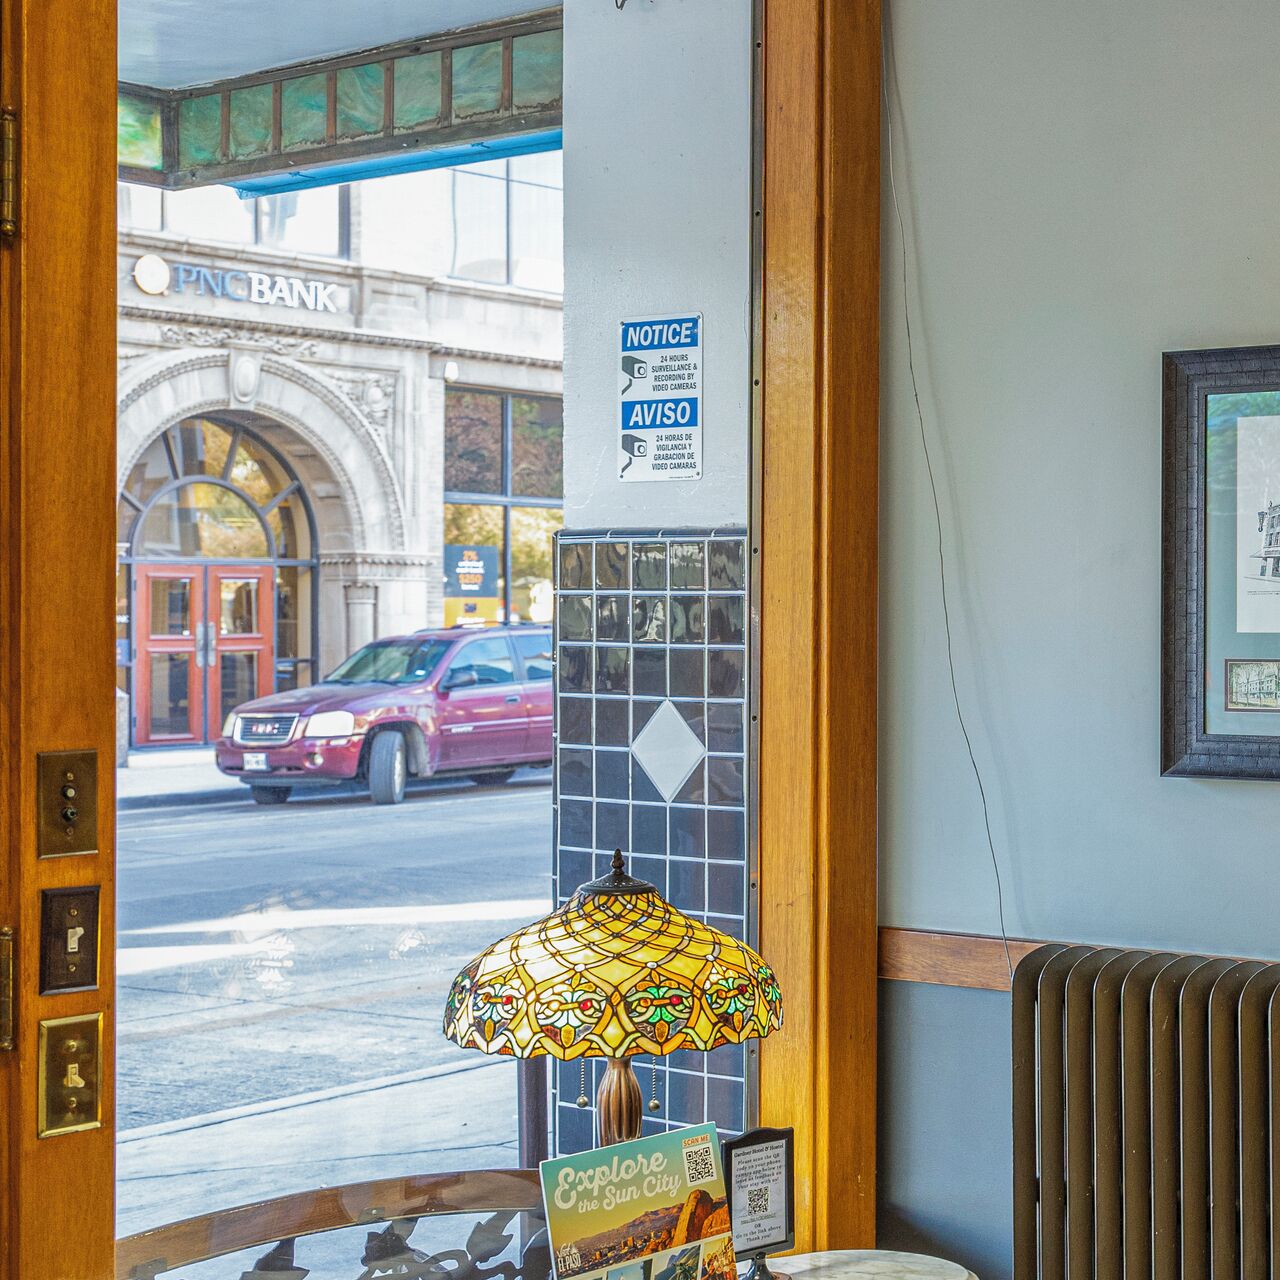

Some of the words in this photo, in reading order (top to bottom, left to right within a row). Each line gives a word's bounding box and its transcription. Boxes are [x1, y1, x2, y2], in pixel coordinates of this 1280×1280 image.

[173, 264, 248, 301] PNC
[247, 272, 338, 313] BANK
[626, 322, 692, 347] NOTICE
[669, 354, 688, 362] HOURS
[652, 364, 691, 373] SURVEILLANCE
[654, 374, 685, 382] RECORDING
[652, 384, 668, 392] VIDEO
[670, 382, 696, 391] CAMERAS
[629, 401, 690, 426] AVISO
[654, 453, 686, 461] GRABACION
[687, 452, 694, 460] DE
[670, 462, 696, 470] CAMARAS
[682, 1137, 698, 1147] SCAN
[699, 1135, 709, 1143] ME
[554, 1152, 667, 1209] Explore
[578, 1198, 600, 1213] the
[603, 1186, 641, 1210] Sun
[643, 1173, 681, 1198] City
[566, 1253, 581, 1271] PASO
